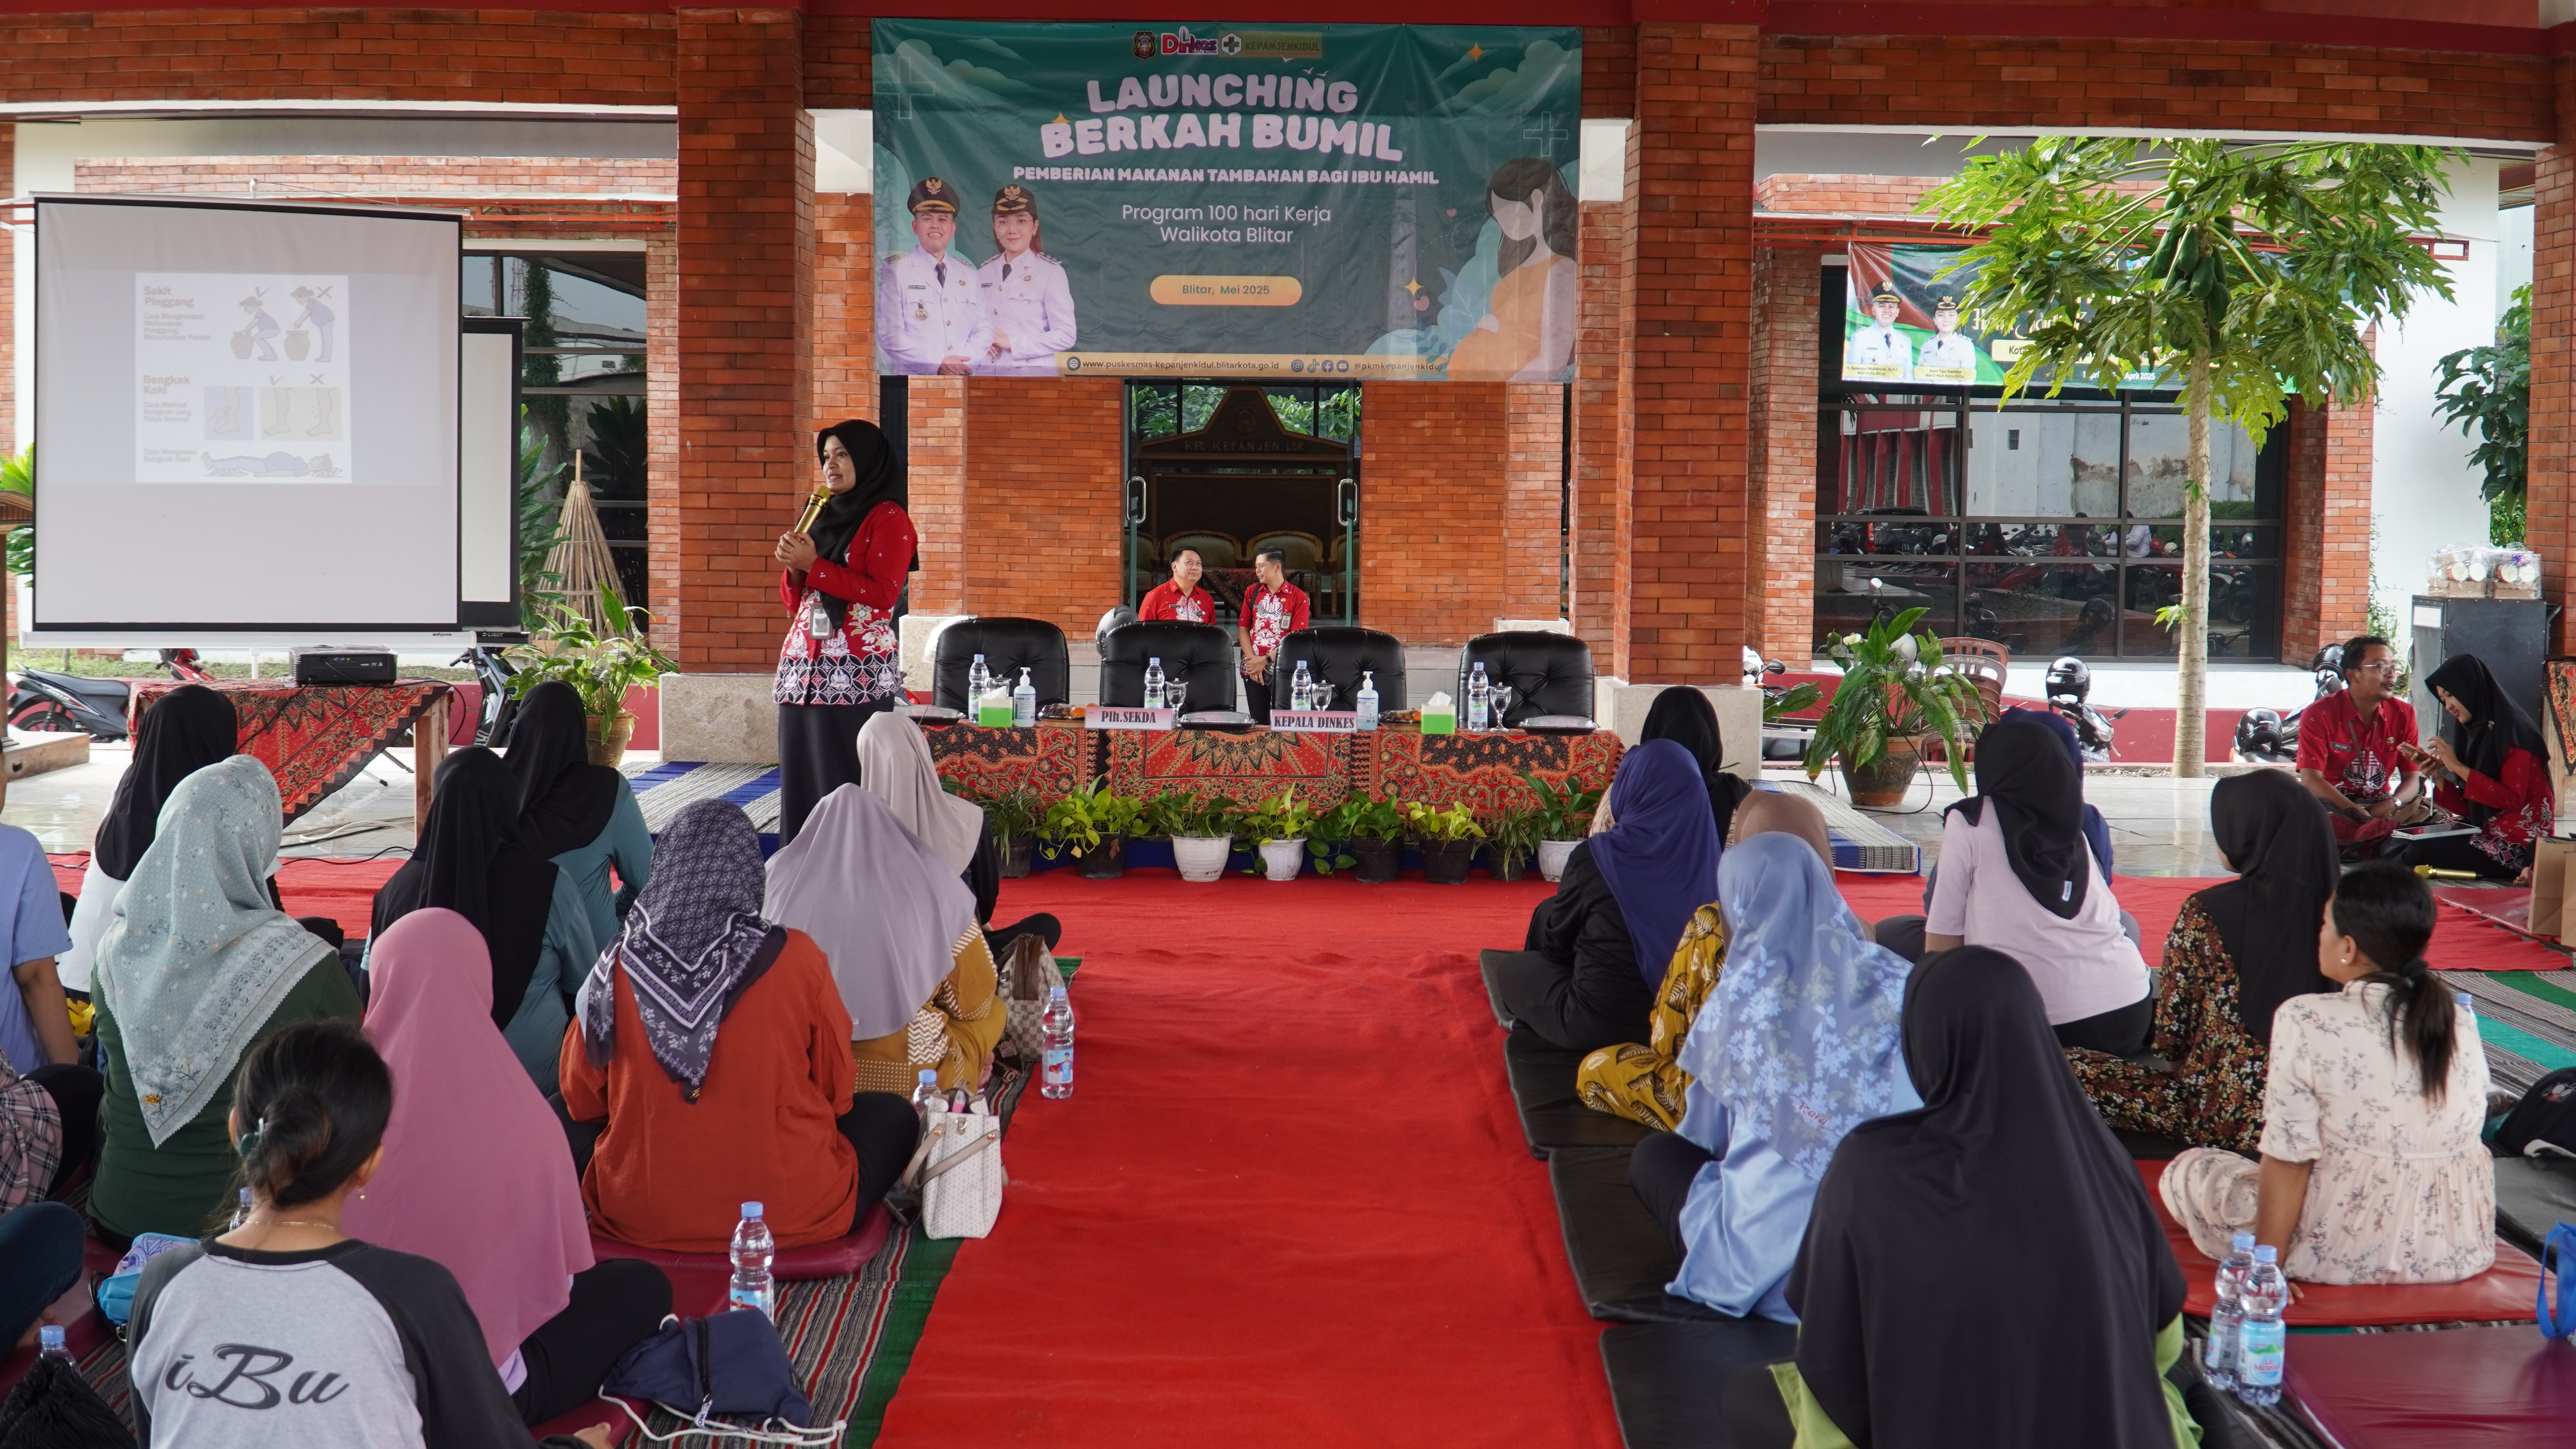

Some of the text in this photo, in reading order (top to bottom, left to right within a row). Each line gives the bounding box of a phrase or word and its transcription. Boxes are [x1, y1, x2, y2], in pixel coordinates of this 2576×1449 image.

[1245, 42, 1320, 51] KEPANJENKIDUL
[1087, 73, 1358, 113] LAUNCHING
[1040, 112, 1403, 161] BERKAH BUMIL
[1013, 166, 1439, 185] PEMBERIAN MAKANAN TAMBAHAN BAGI IBU HAMIL
[1122, 203, 1331, 225] Program 100 hari Kerja
[1160, 227, 1293, 243] Walikota Blitar
[144, 286, 171, 296] Sakit
[1182, 283, 1270, 296] Blitar, Mei 2025
[144, 297, 194, 308] Pinggang
[1082, 360, 1279, 370] www.puskesmas-kepanjenkidul.blitarkota.go.id
[1354, 362, 1443, 372] @pkmkepanjenkidul
[143, 375, 191, 386] Bengkak
[2125, 372, 2156, 381] April 2025
[143, 386, 167, 394] Kaki
[1274, 715, 1355, 728] KEPALA DINKES
[165, 1343, 350, 1410] iBu
